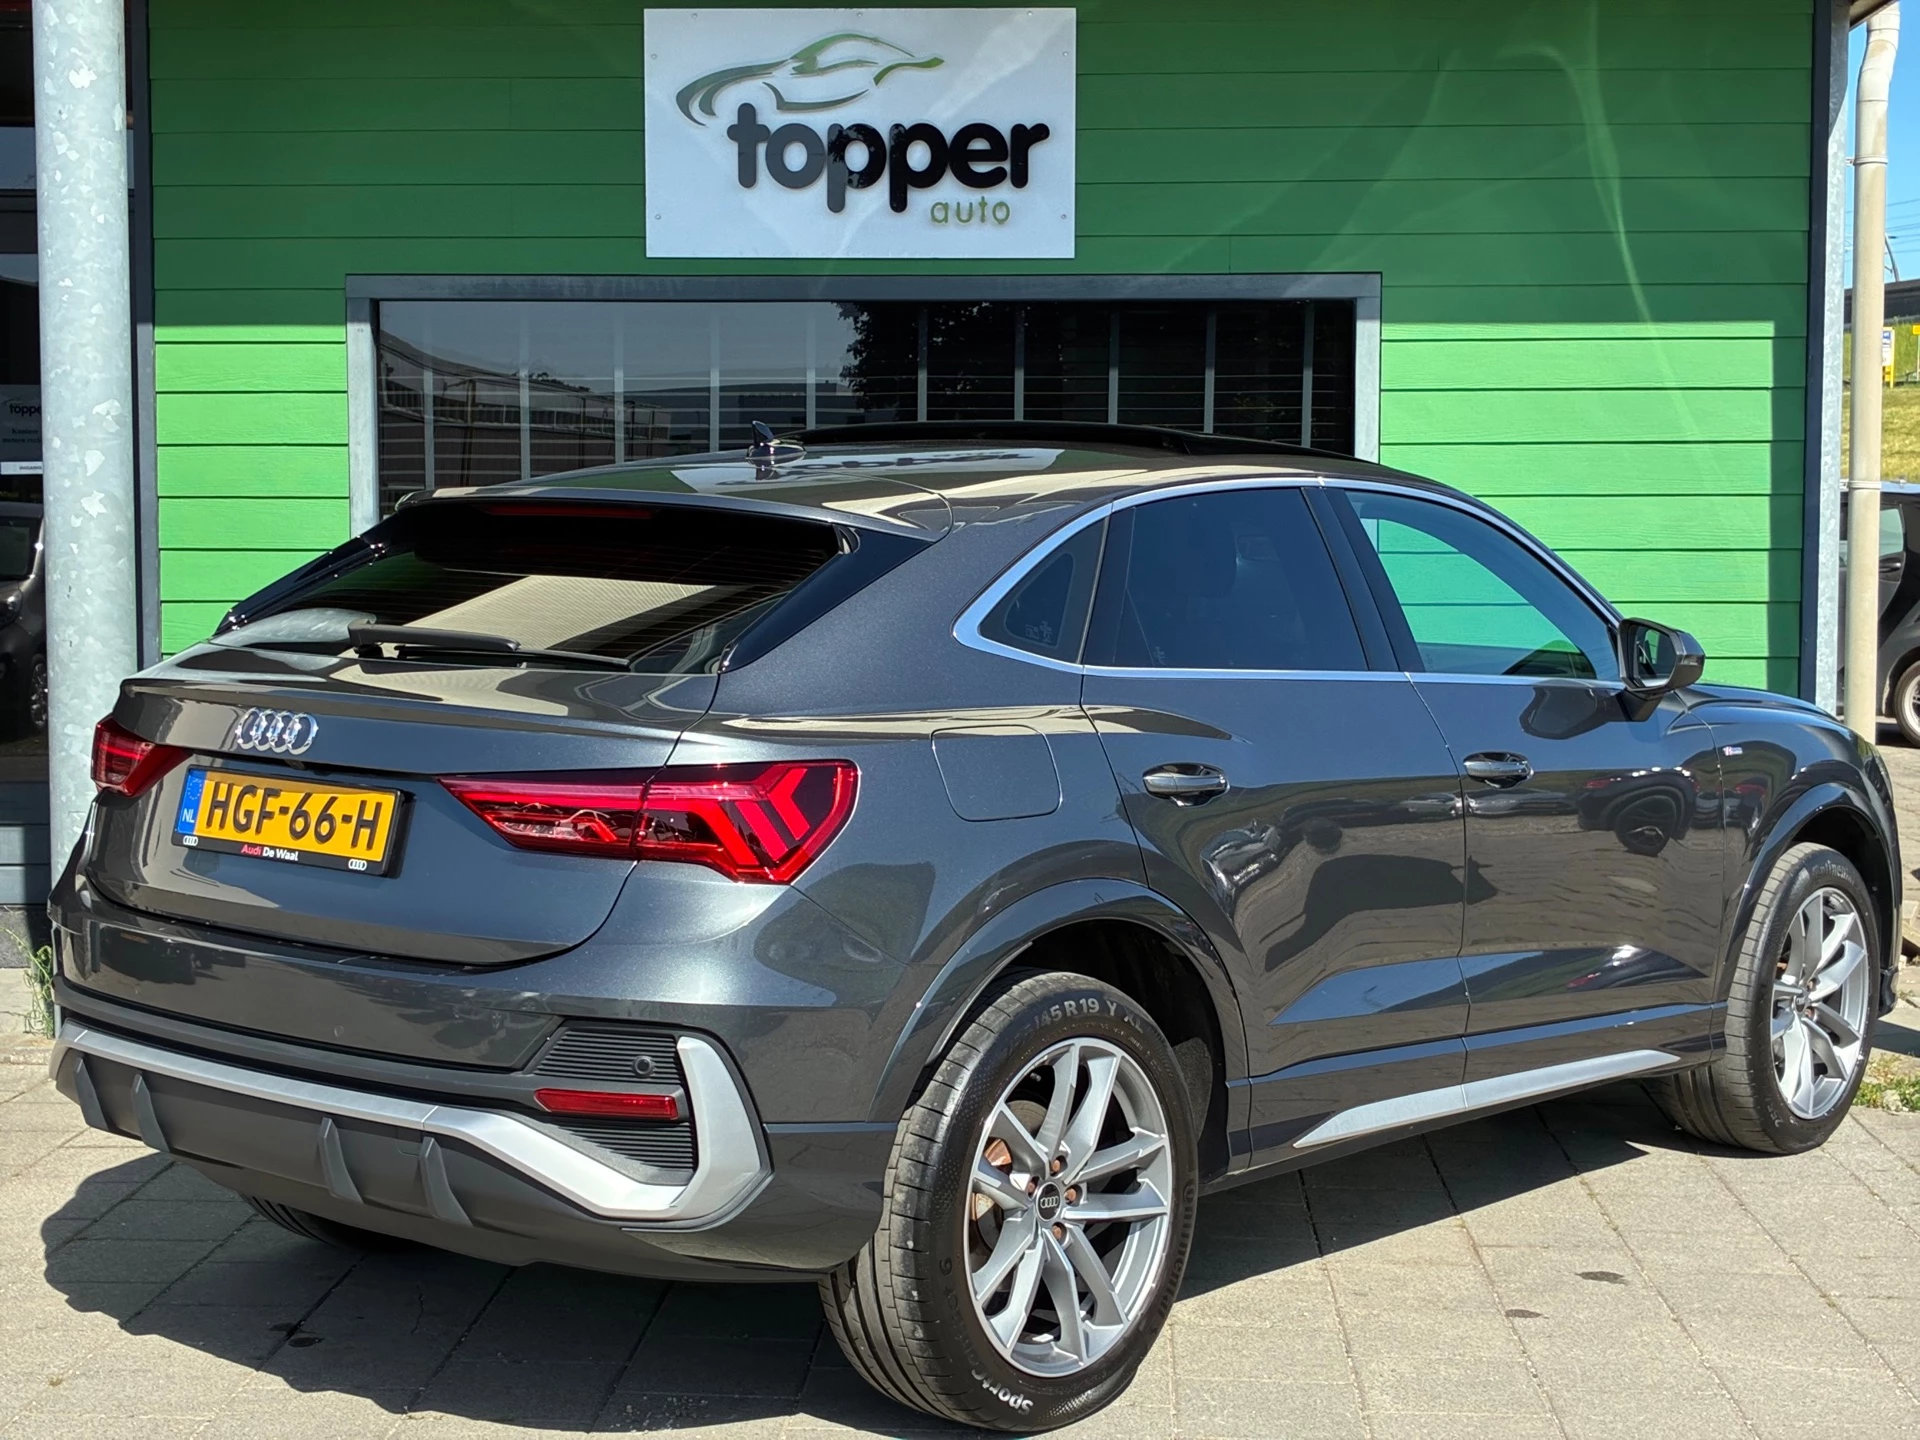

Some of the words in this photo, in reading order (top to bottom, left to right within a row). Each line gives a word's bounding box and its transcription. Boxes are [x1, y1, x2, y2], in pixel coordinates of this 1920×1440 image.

[727, 102, 1050, 213] topper
[930, 196, 1011, 224] auto
[182, 808, 195, 823] NL
[205, 780, 383, 850] HGF-66-H
[241, 844, 262, 856] Audi
[262, 846, 275, 857] De
[276, 848, 299, 861] Waal
